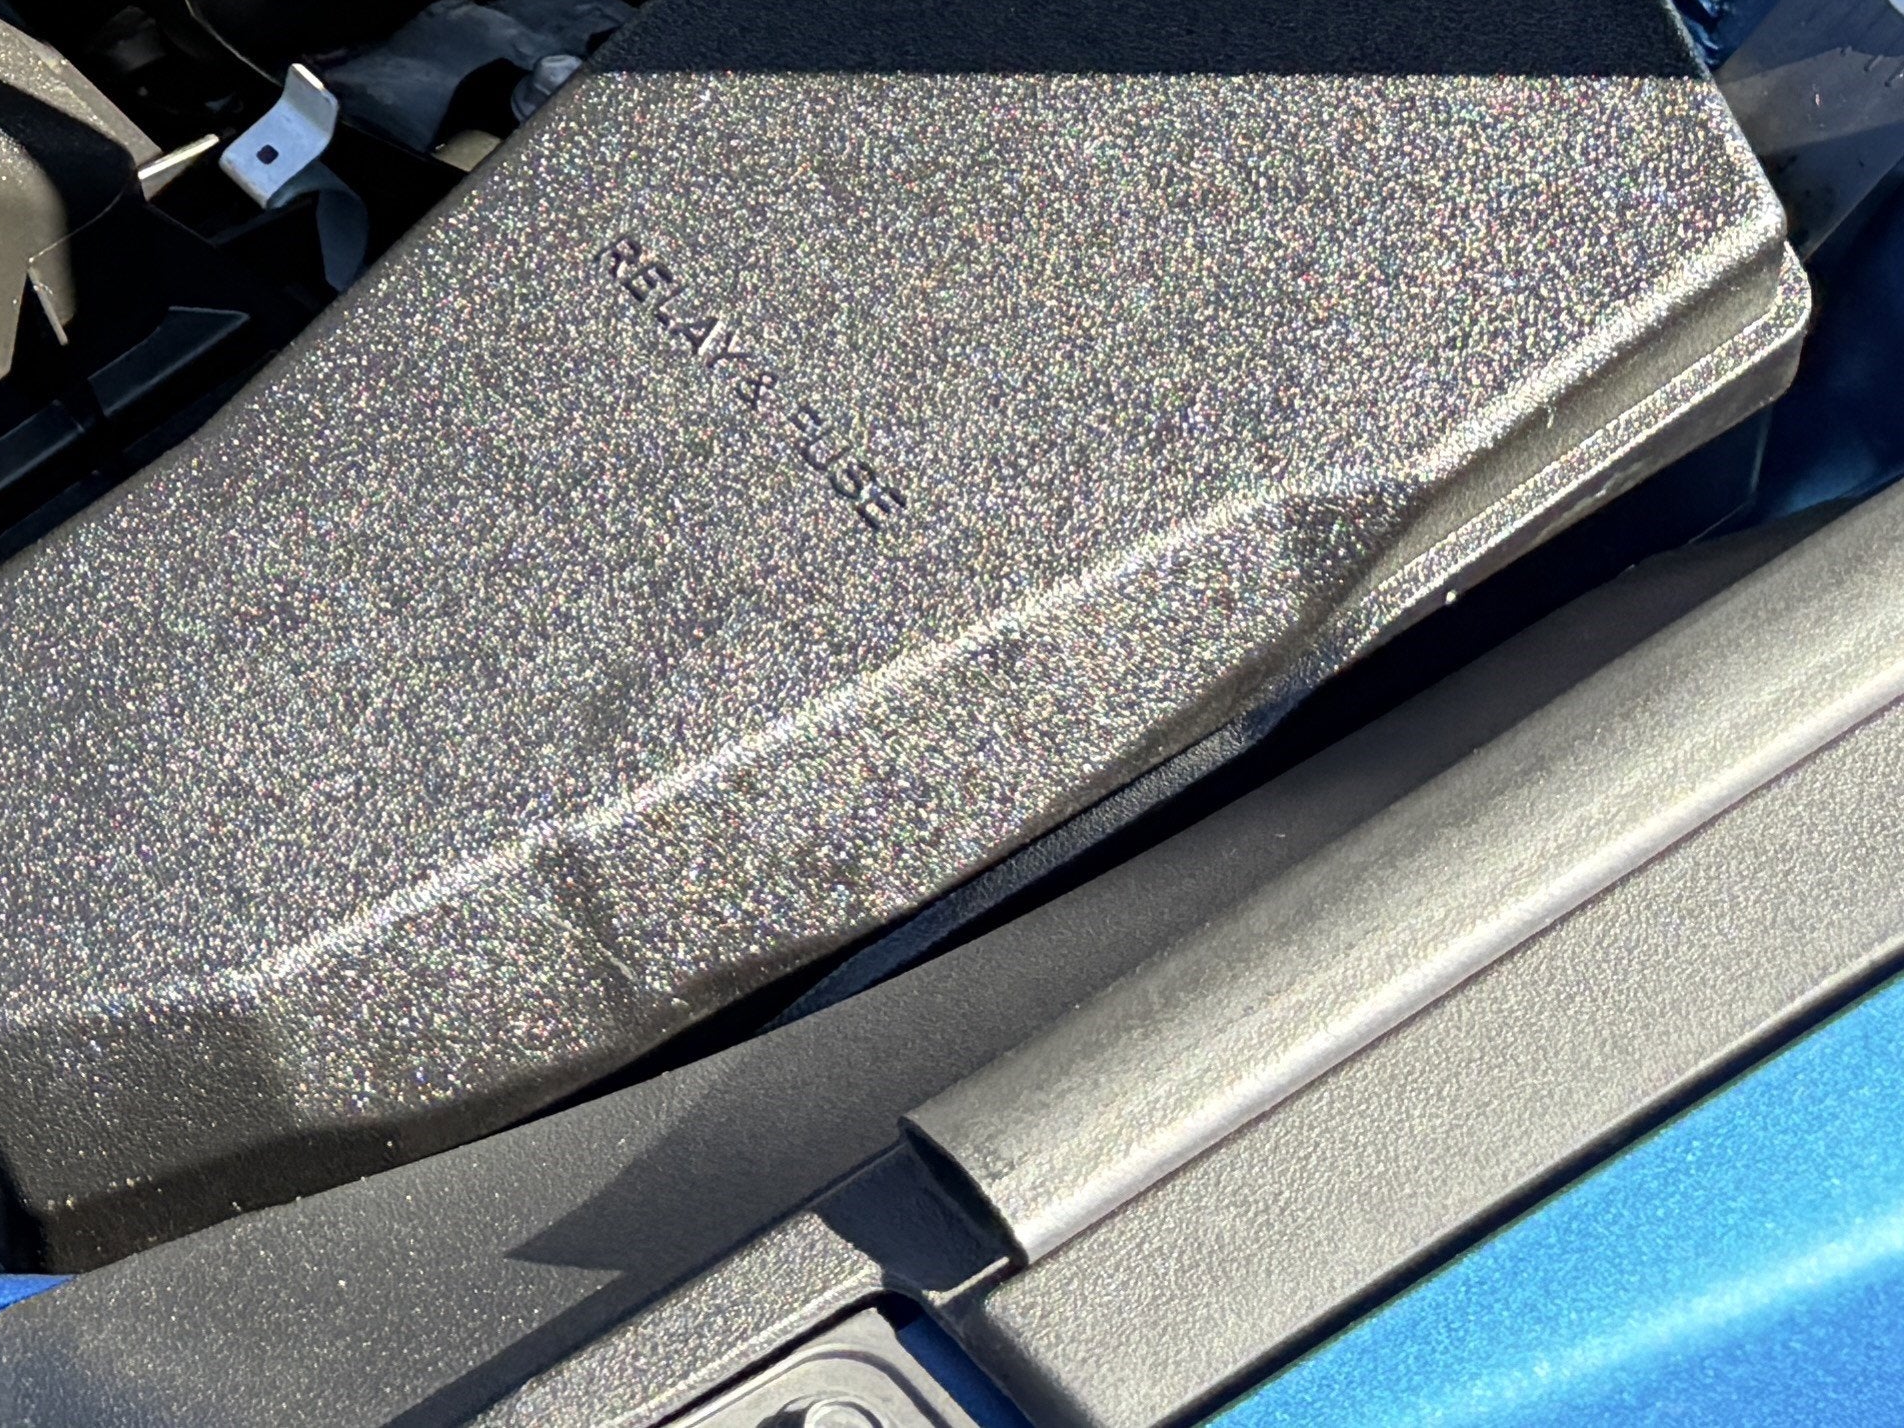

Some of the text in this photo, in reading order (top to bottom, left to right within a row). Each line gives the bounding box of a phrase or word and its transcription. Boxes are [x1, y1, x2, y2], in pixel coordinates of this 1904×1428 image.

[594, 234, 907, 531] RELAY & FUSE
